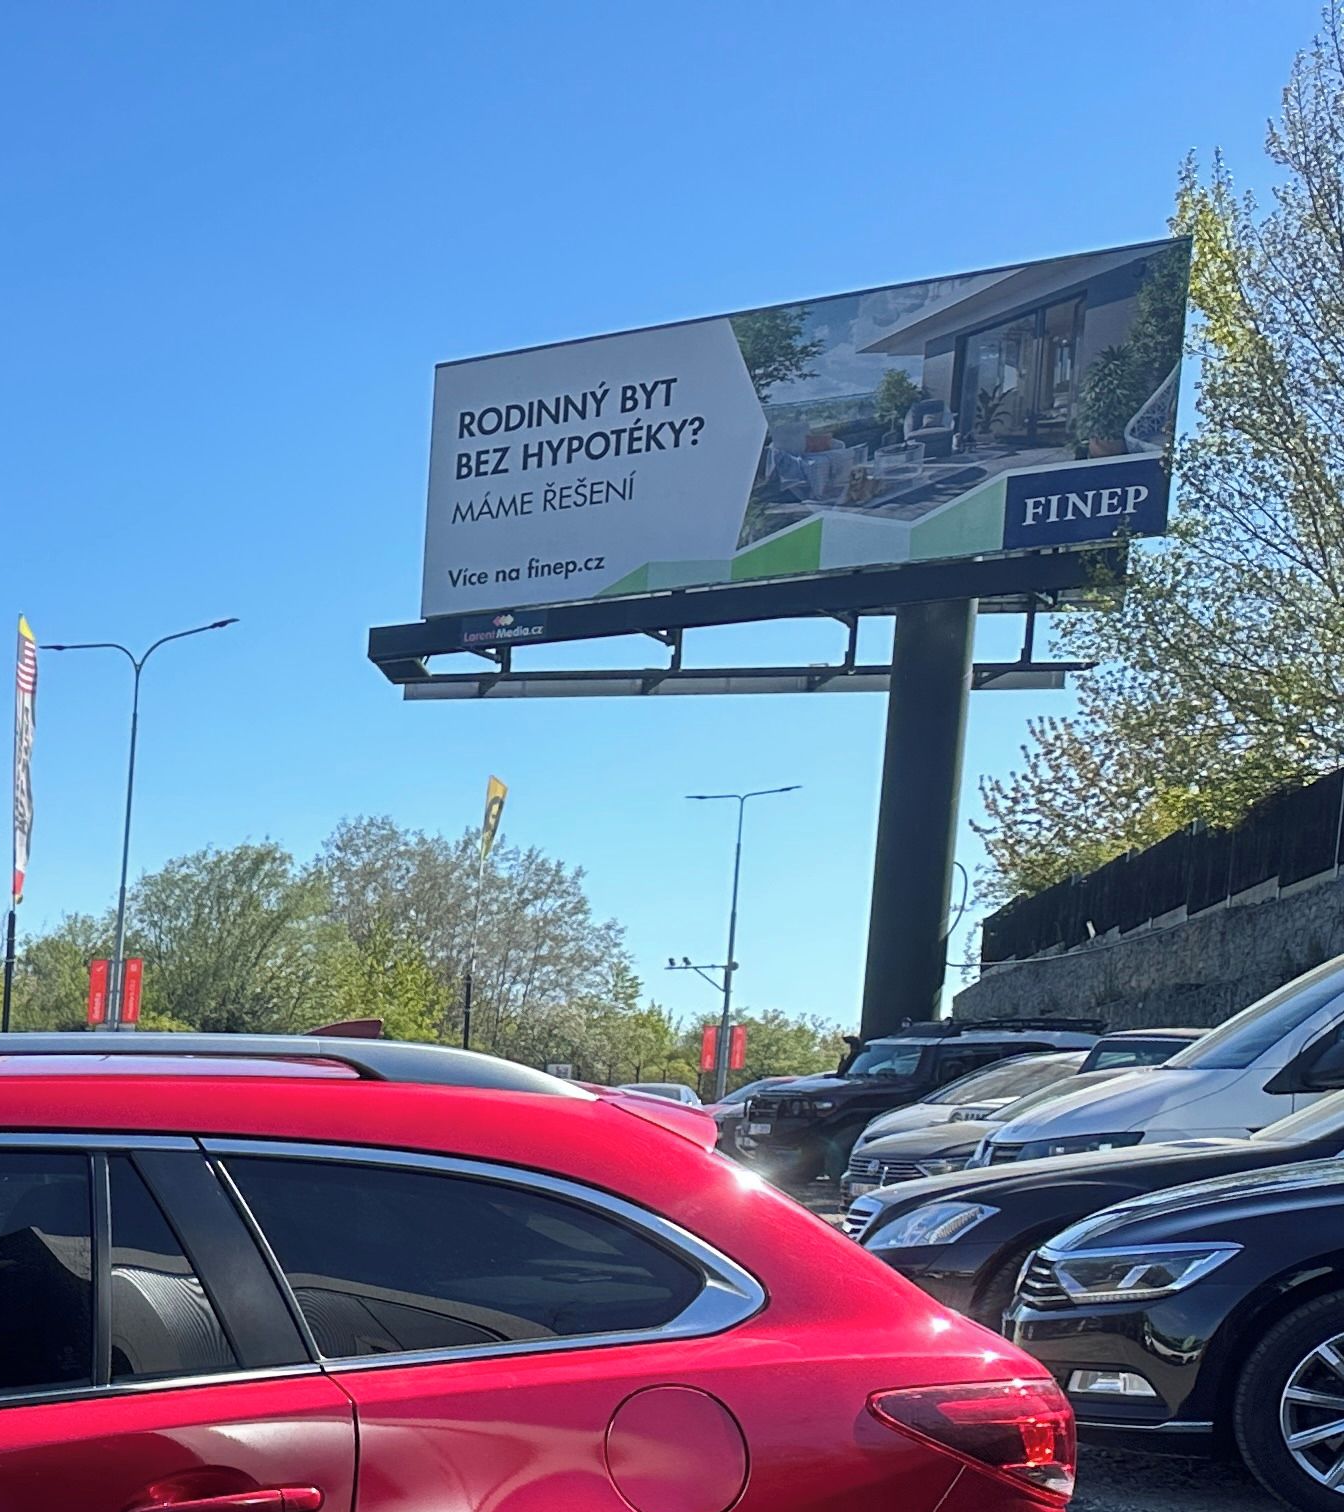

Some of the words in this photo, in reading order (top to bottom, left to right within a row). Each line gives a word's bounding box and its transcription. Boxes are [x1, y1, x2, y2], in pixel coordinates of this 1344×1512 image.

[458, 381, 610, 439] RODINNÝ
[620, 377, 677, 414] BYT
[456, 446, 510, 480] BEZ
[522, 416, 705, 471] HYPOTÉKY?
[452, 491, 534, 524] MÁME
[543, 470, 637, 512] ŘEŠENÍ
[1021, 485, 1149, 526] FINEP
[448, 568, 489, 587] Více
[495, 566, 520, 583] na
[527, 556, 606, 580] finep.cz
